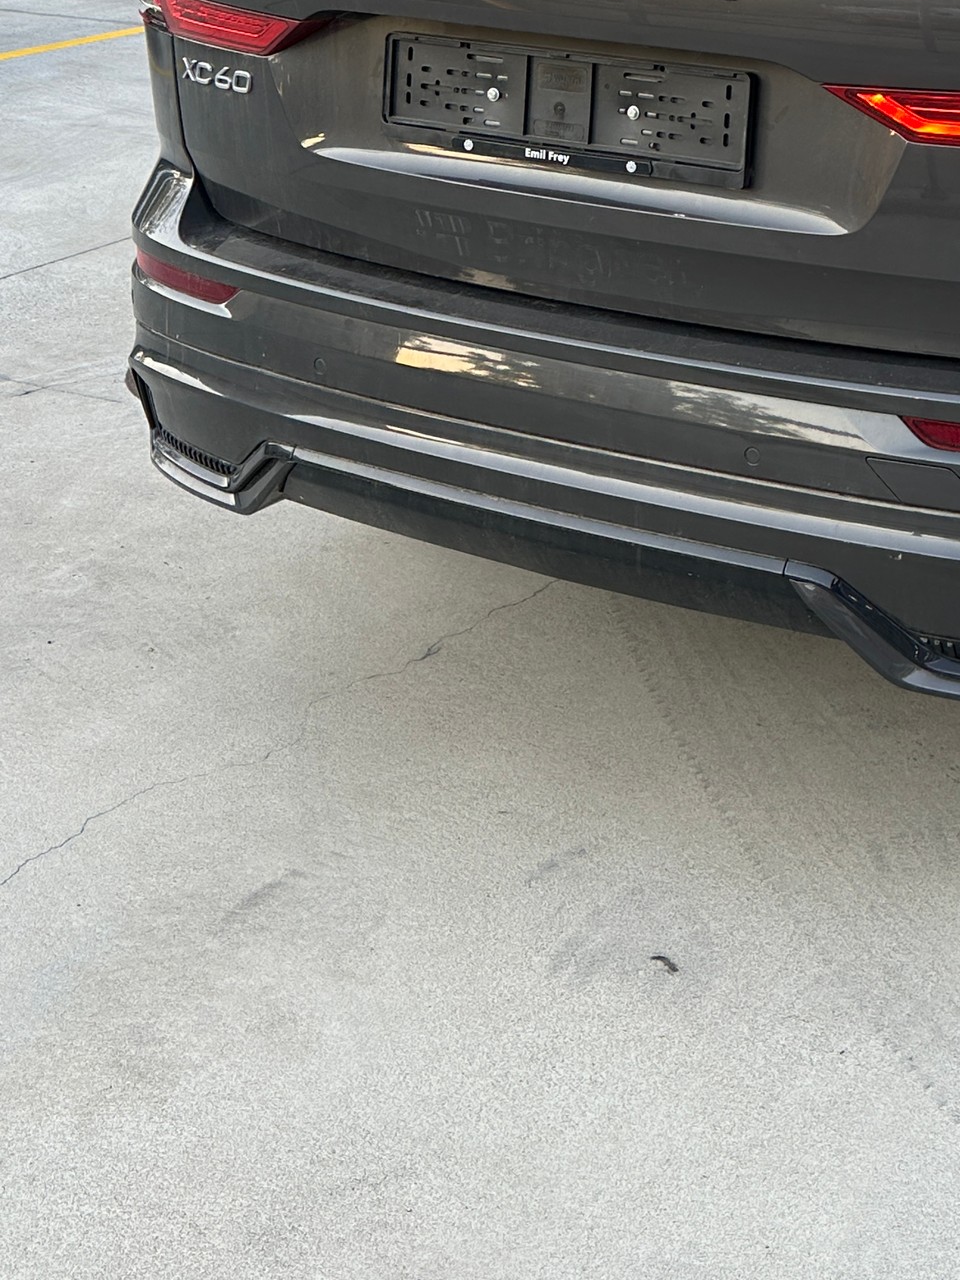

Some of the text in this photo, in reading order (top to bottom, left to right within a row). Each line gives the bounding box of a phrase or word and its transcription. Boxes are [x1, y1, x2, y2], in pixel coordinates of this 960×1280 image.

[182, 56, 252, 94] XC60
[525, 147, 570, 165] Emil Frey
